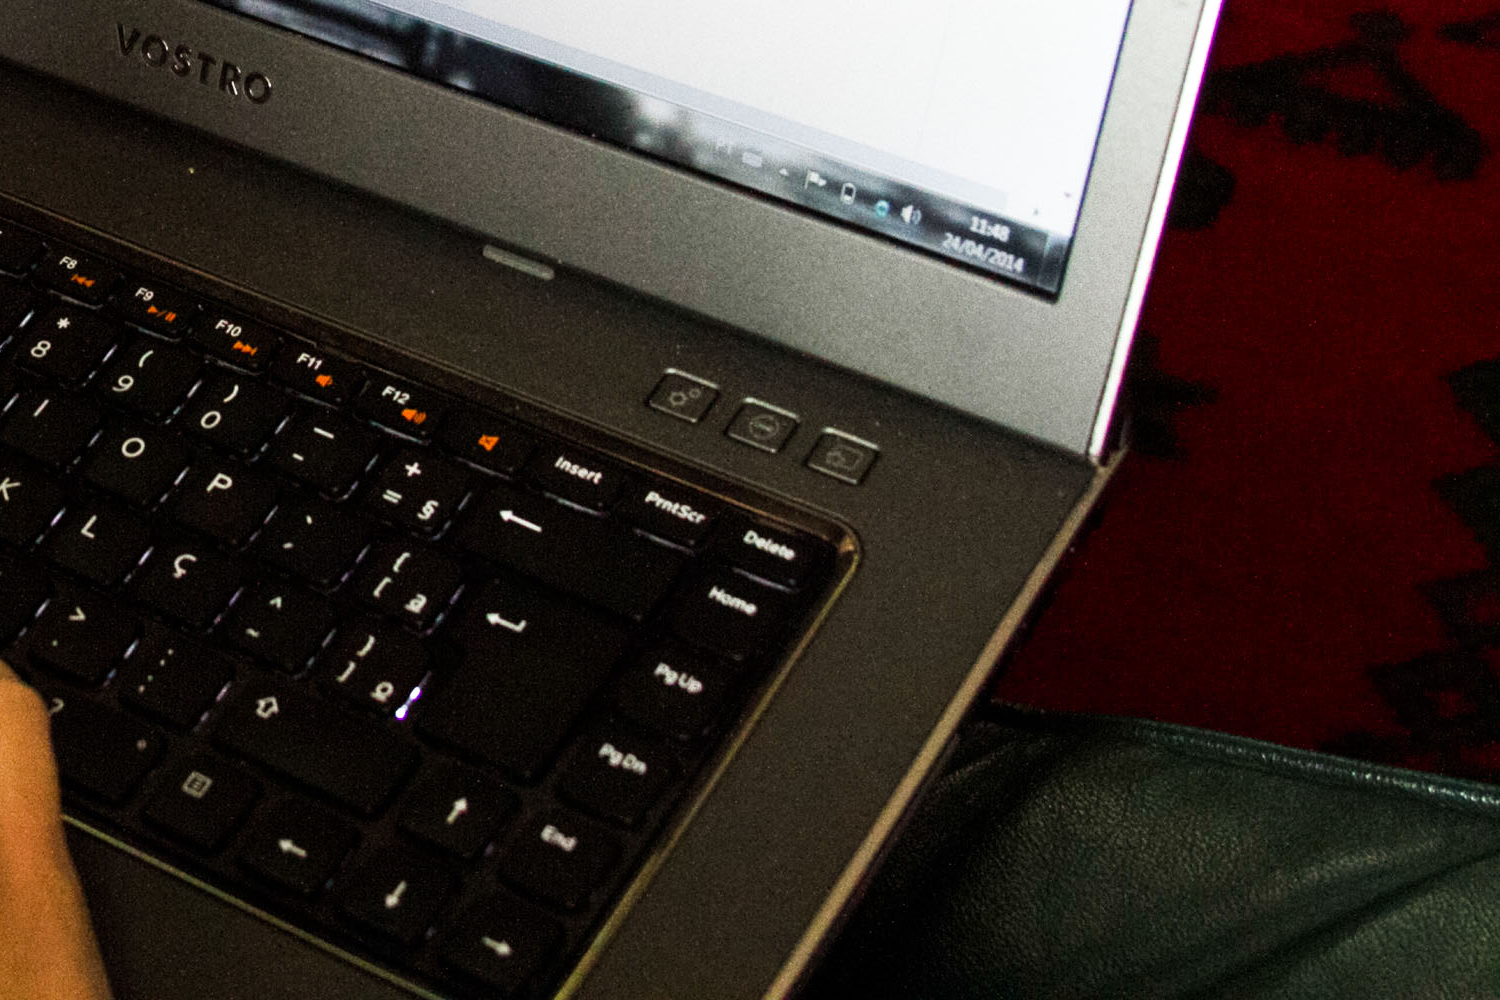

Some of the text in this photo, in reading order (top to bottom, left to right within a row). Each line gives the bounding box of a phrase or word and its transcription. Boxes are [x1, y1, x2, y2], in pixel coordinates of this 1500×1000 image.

[116, 21, 272, 104] VOSTRO
[59, 256, 78, 270] F8
[135, 287, 155, 302] F9
[215, 319, 243, 337] F10
[30, 340, 51, 358] 8
[296, 353, 324, 371] F11
[112, 374, 135, 393] 9
[381, 385, 411, 404] F12
[120, 436, 146, 459] O
[553, 455, 603, 486] Insert
[206, 472, 234, 494] P
[644, 490, 706, 525] PrntScr
[80, 515, 98, 539] L
[742, 529, 797, 562] Delete
[707, 584, 758, 617] Home
[540, 824, 578, 852] End
